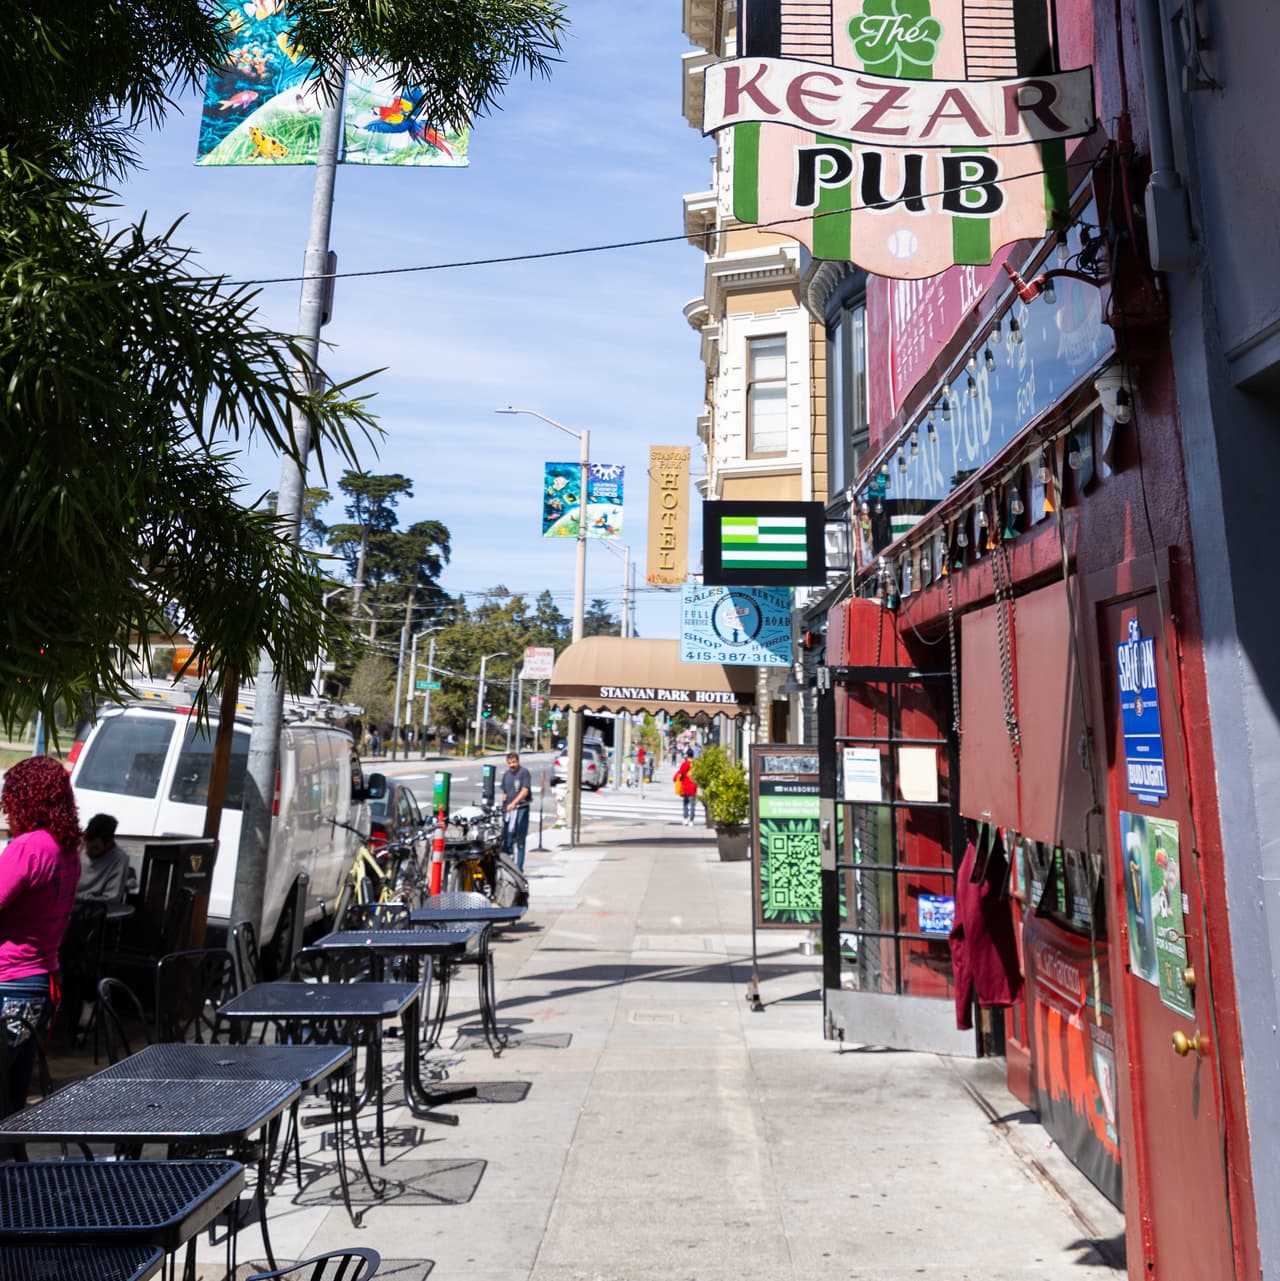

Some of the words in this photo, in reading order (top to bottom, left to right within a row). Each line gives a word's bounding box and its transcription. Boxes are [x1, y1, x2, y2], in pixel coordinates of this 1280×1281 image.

[860, 13, 928, 47] The
[722, 63, 1071, 139] KEZAR
[795, 147, 1005, 214] PUB
[660, 472, 679, 570] HOTEL
[684, 588, 724, 604] SALES
[684, 610, 709, 619] FULL
[765, 618, 791, 626] ROAD
[684, 632, 722, 649] SHOP
[752, 635, 790, 651] HYBRID
[600, 687, 655, 699] STANYAN
[658, 688, 690, 701] PARK
[696, 691, 739, 704] HOTEL
